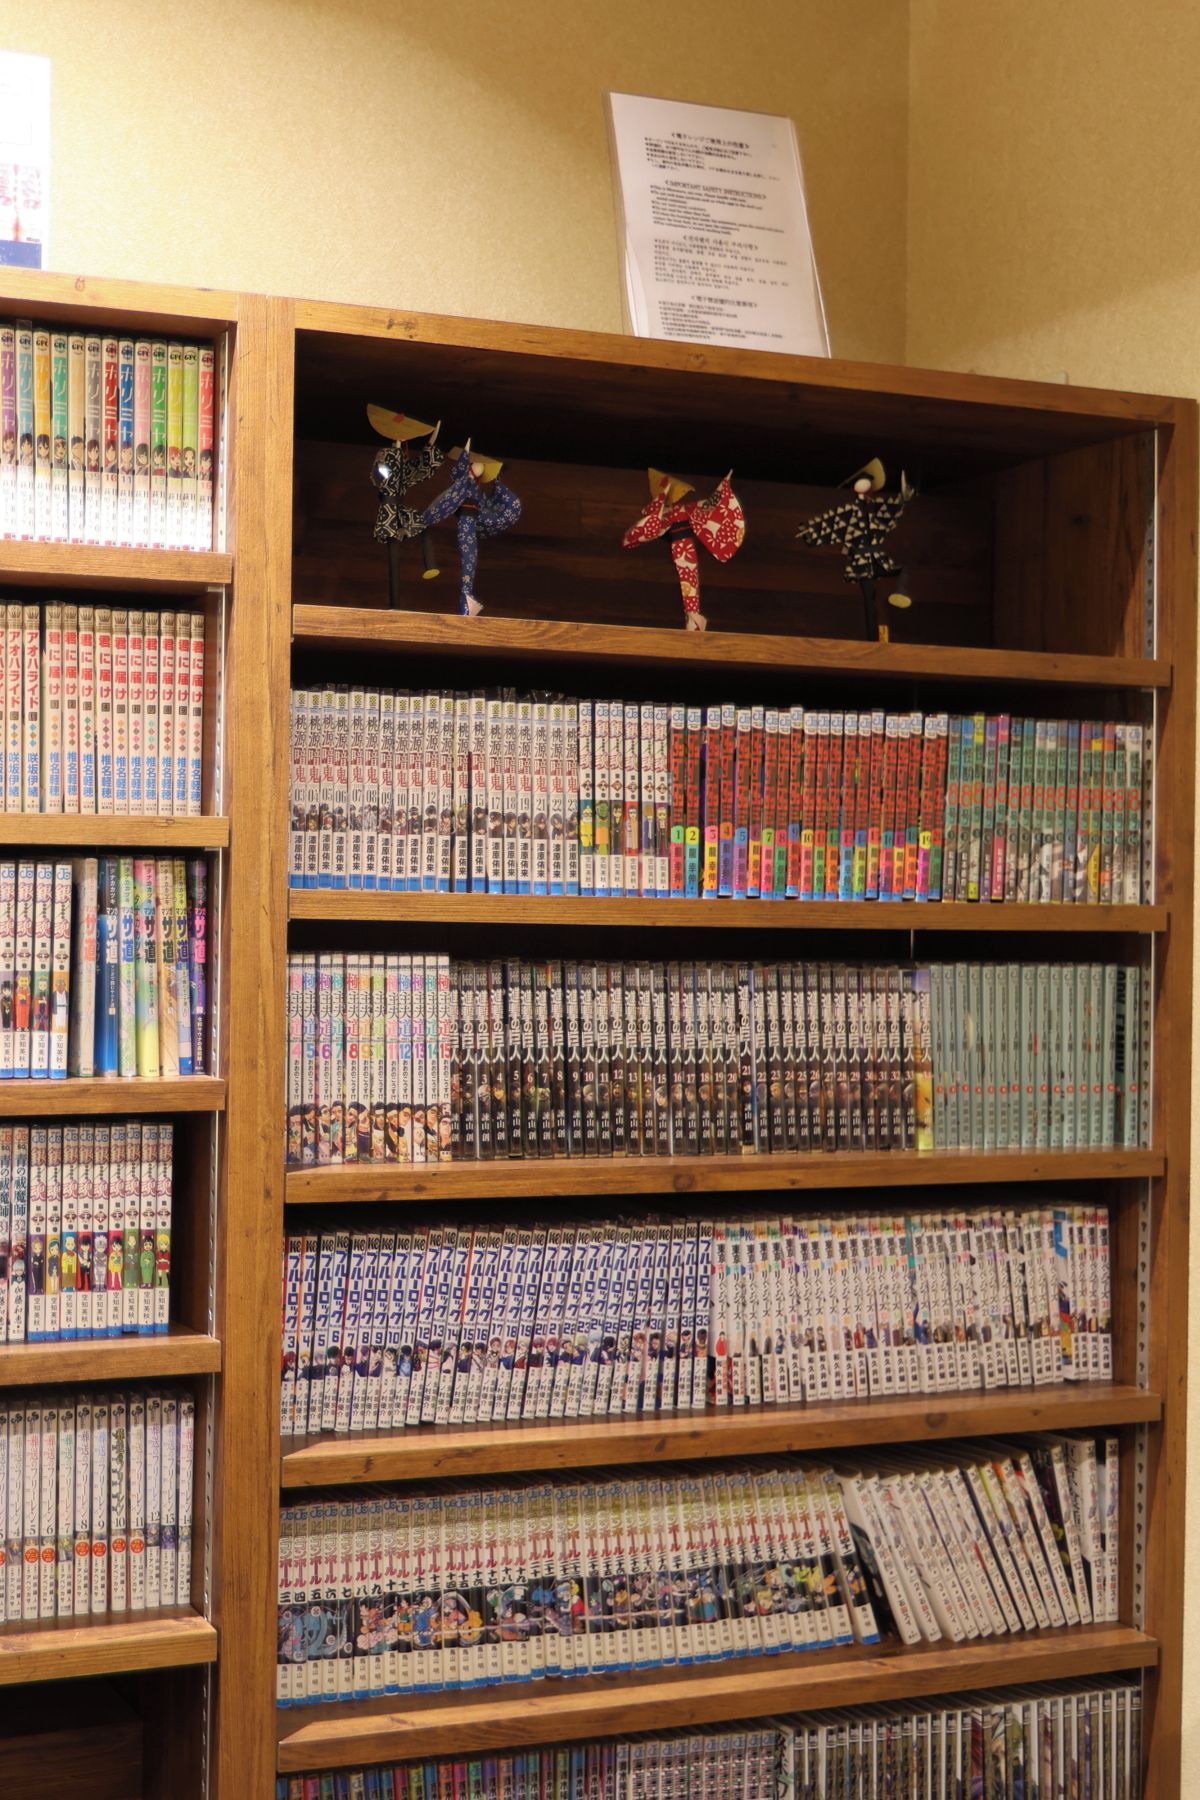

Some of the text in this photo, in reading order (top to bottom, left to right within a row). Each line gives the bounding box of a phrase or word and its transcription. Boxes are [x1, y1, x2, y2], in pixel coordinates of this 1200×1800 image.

[27, 632, 39, 710] アオハライド
[331, 1250, 348, 1324] ブルーロック
[361, 1252, 378, 1325] ブルーロック
[390, 1252, 408, 1325] ブルーロック
[420, 1248, 440, 1321] ブルーロック
